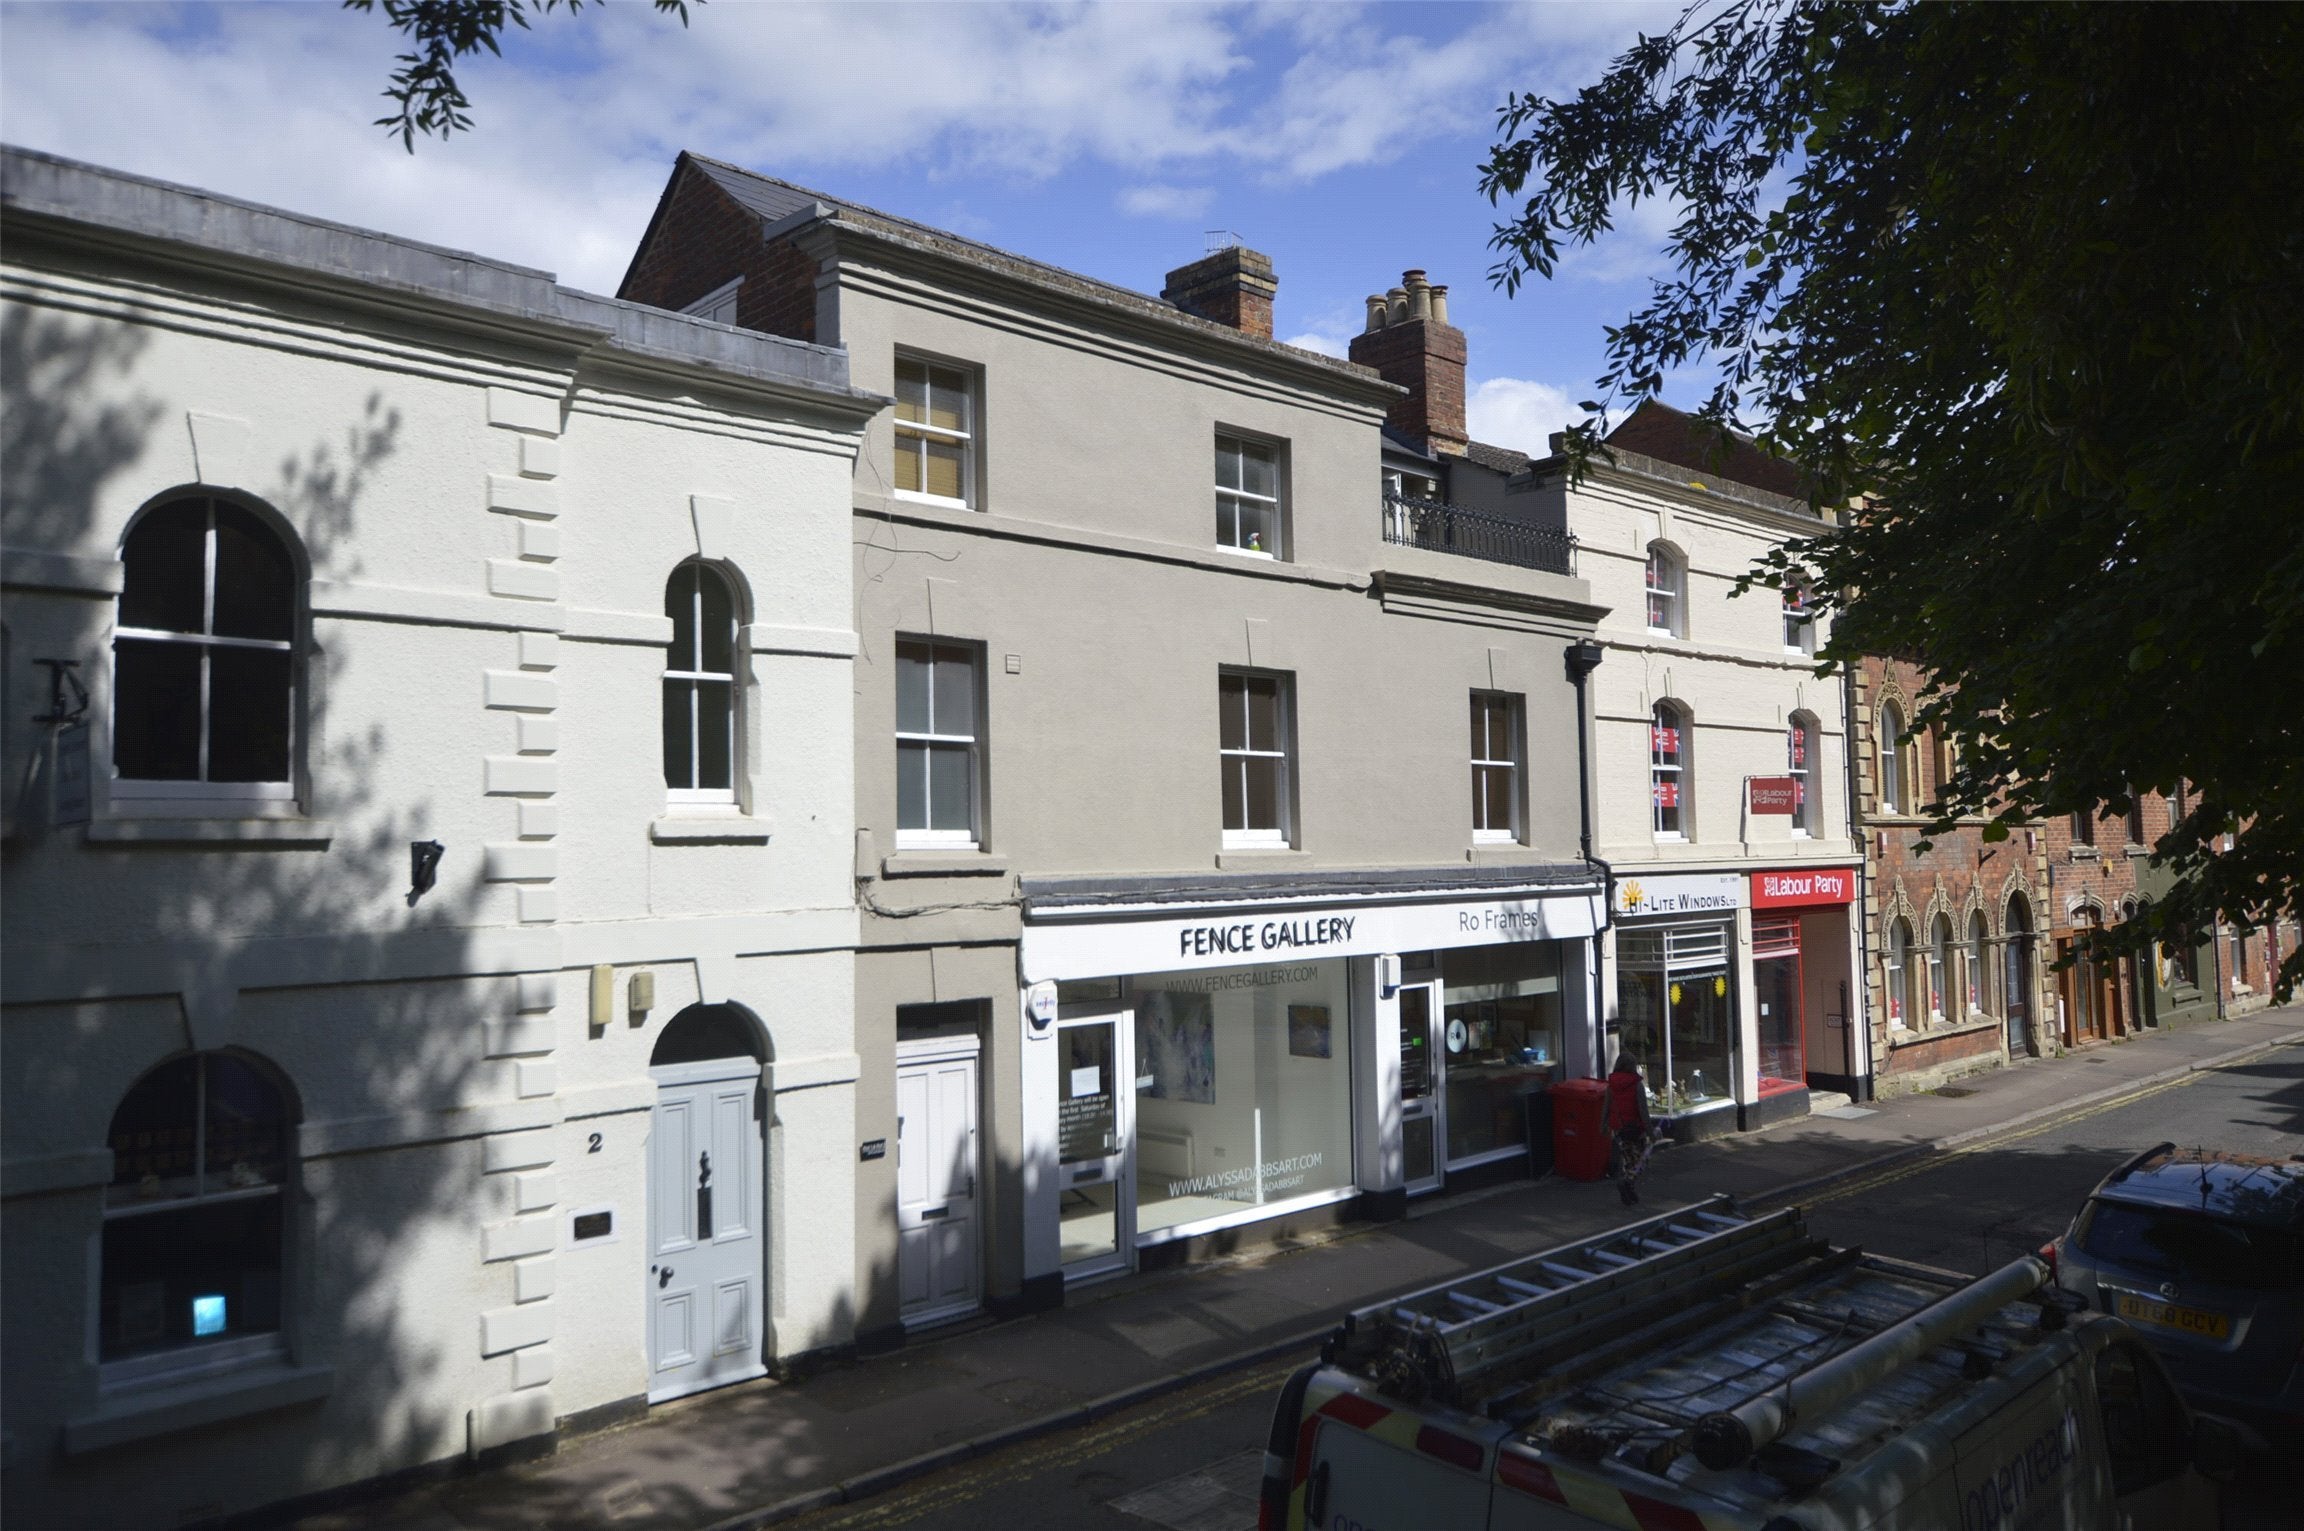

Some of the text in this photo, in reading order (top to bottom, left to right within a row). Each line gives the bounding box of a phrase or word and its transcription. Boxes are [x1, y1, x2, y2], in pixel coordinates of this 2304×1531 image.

[1766, 797, 1788, 806] Party
[1767, 789, 1792, 797] Labour
[1775, 875, 1843, 898] Labour Party
[1459, 910, 1538, 932] Ro Frames
[1180, 916, 1356, 957] FENCE GALLERY
[1165, 966, 1319, 993] WWW.FENCEGALLERY.COM
[587, 1132, 603, 1154] 2
